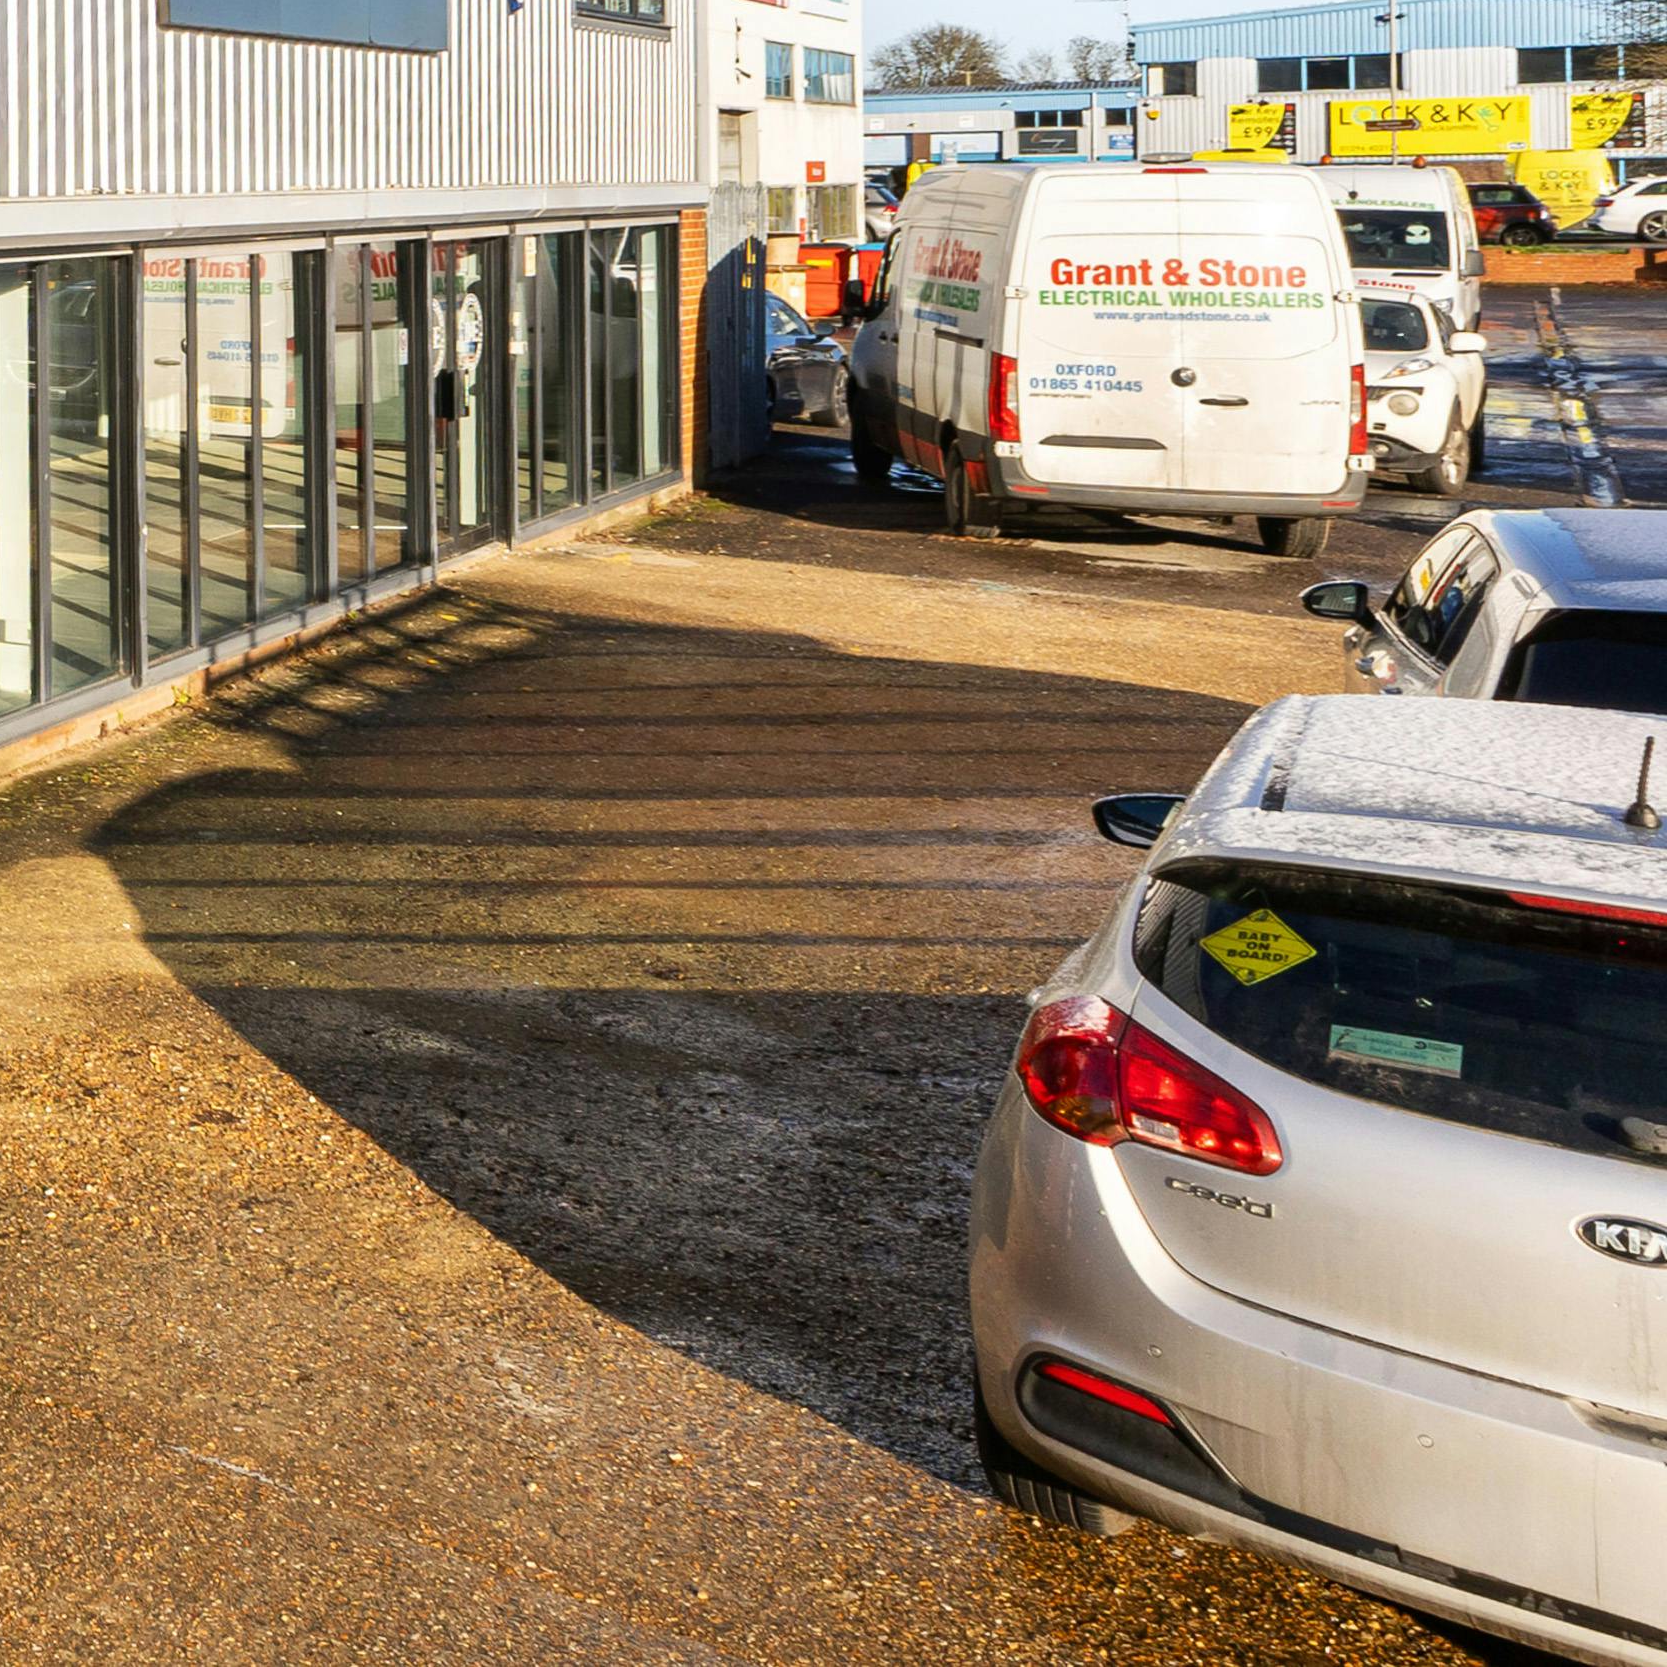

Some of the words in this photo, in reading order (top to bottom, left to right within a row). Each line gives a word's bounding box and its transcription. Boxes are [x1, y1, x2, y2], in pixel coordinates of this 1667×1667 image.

[1431, 104, 1451, 123] &
[1244, 127, 1274, 139] £99
[1051, 258, 1152, 285] Grant
[1162, 259, 1190, 285] &
[1199, 258, 1307, 287] Stone
[1039, 290, 1163, 306] ELECTRICAL
[1169, 291, 1324, 308] WHOLESALERS
[1094, 310, 1271, 322] www.grantandstone.co.uk
[1055, 364, 1117, 376] OXFORD
[1030, 378, 1078, 391] 01865
[1084, 380, 1143, 393] 410445
[1237, 930, 1282, 943] BABY
[1245, 940, 1271, 951] ON
[1226, 948, 1290, 963] BOARD!
